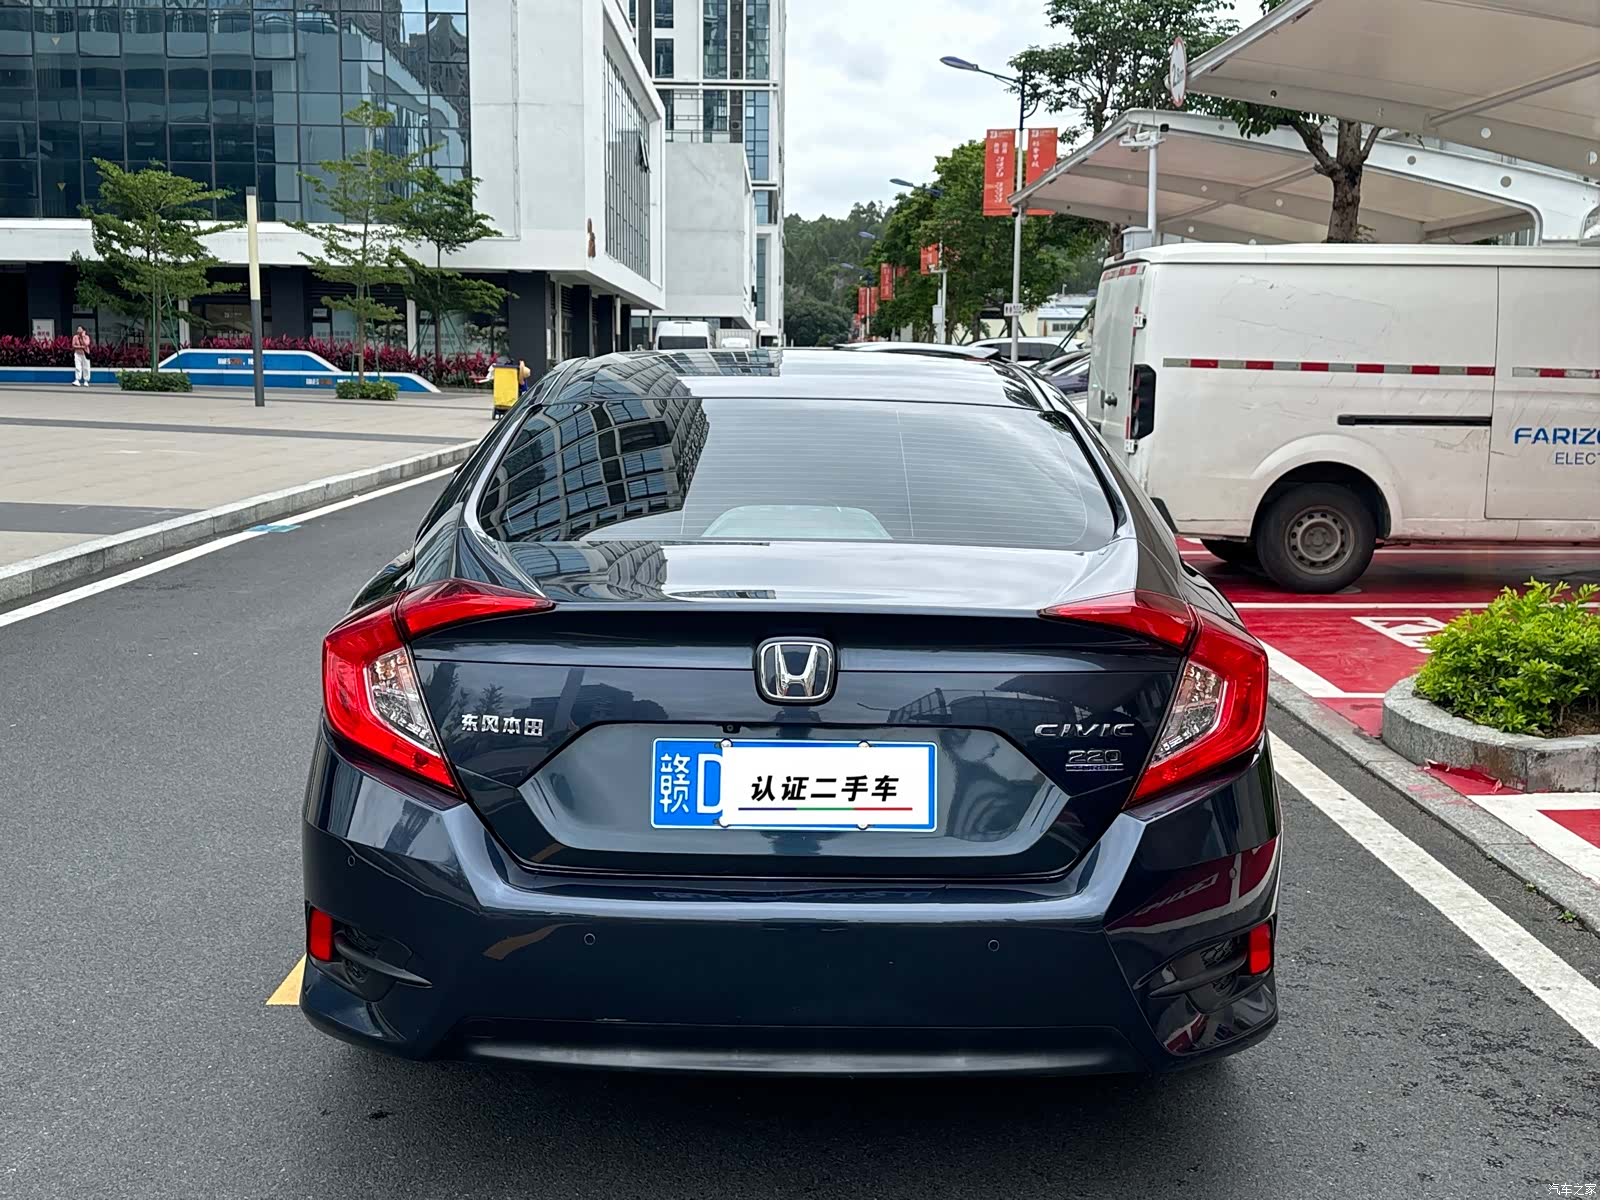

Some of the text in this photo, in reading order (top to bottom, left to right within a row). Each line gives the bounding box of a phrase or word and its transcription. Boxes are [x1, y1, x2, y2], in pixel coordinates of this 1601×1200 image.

[1514, 427, 1600, 445] FARIZ
[461, 713, 544, 737] 东风本田
[1034, 723, 1135, 738] CIVIC
[1068, 749, 1121, 764] 220
